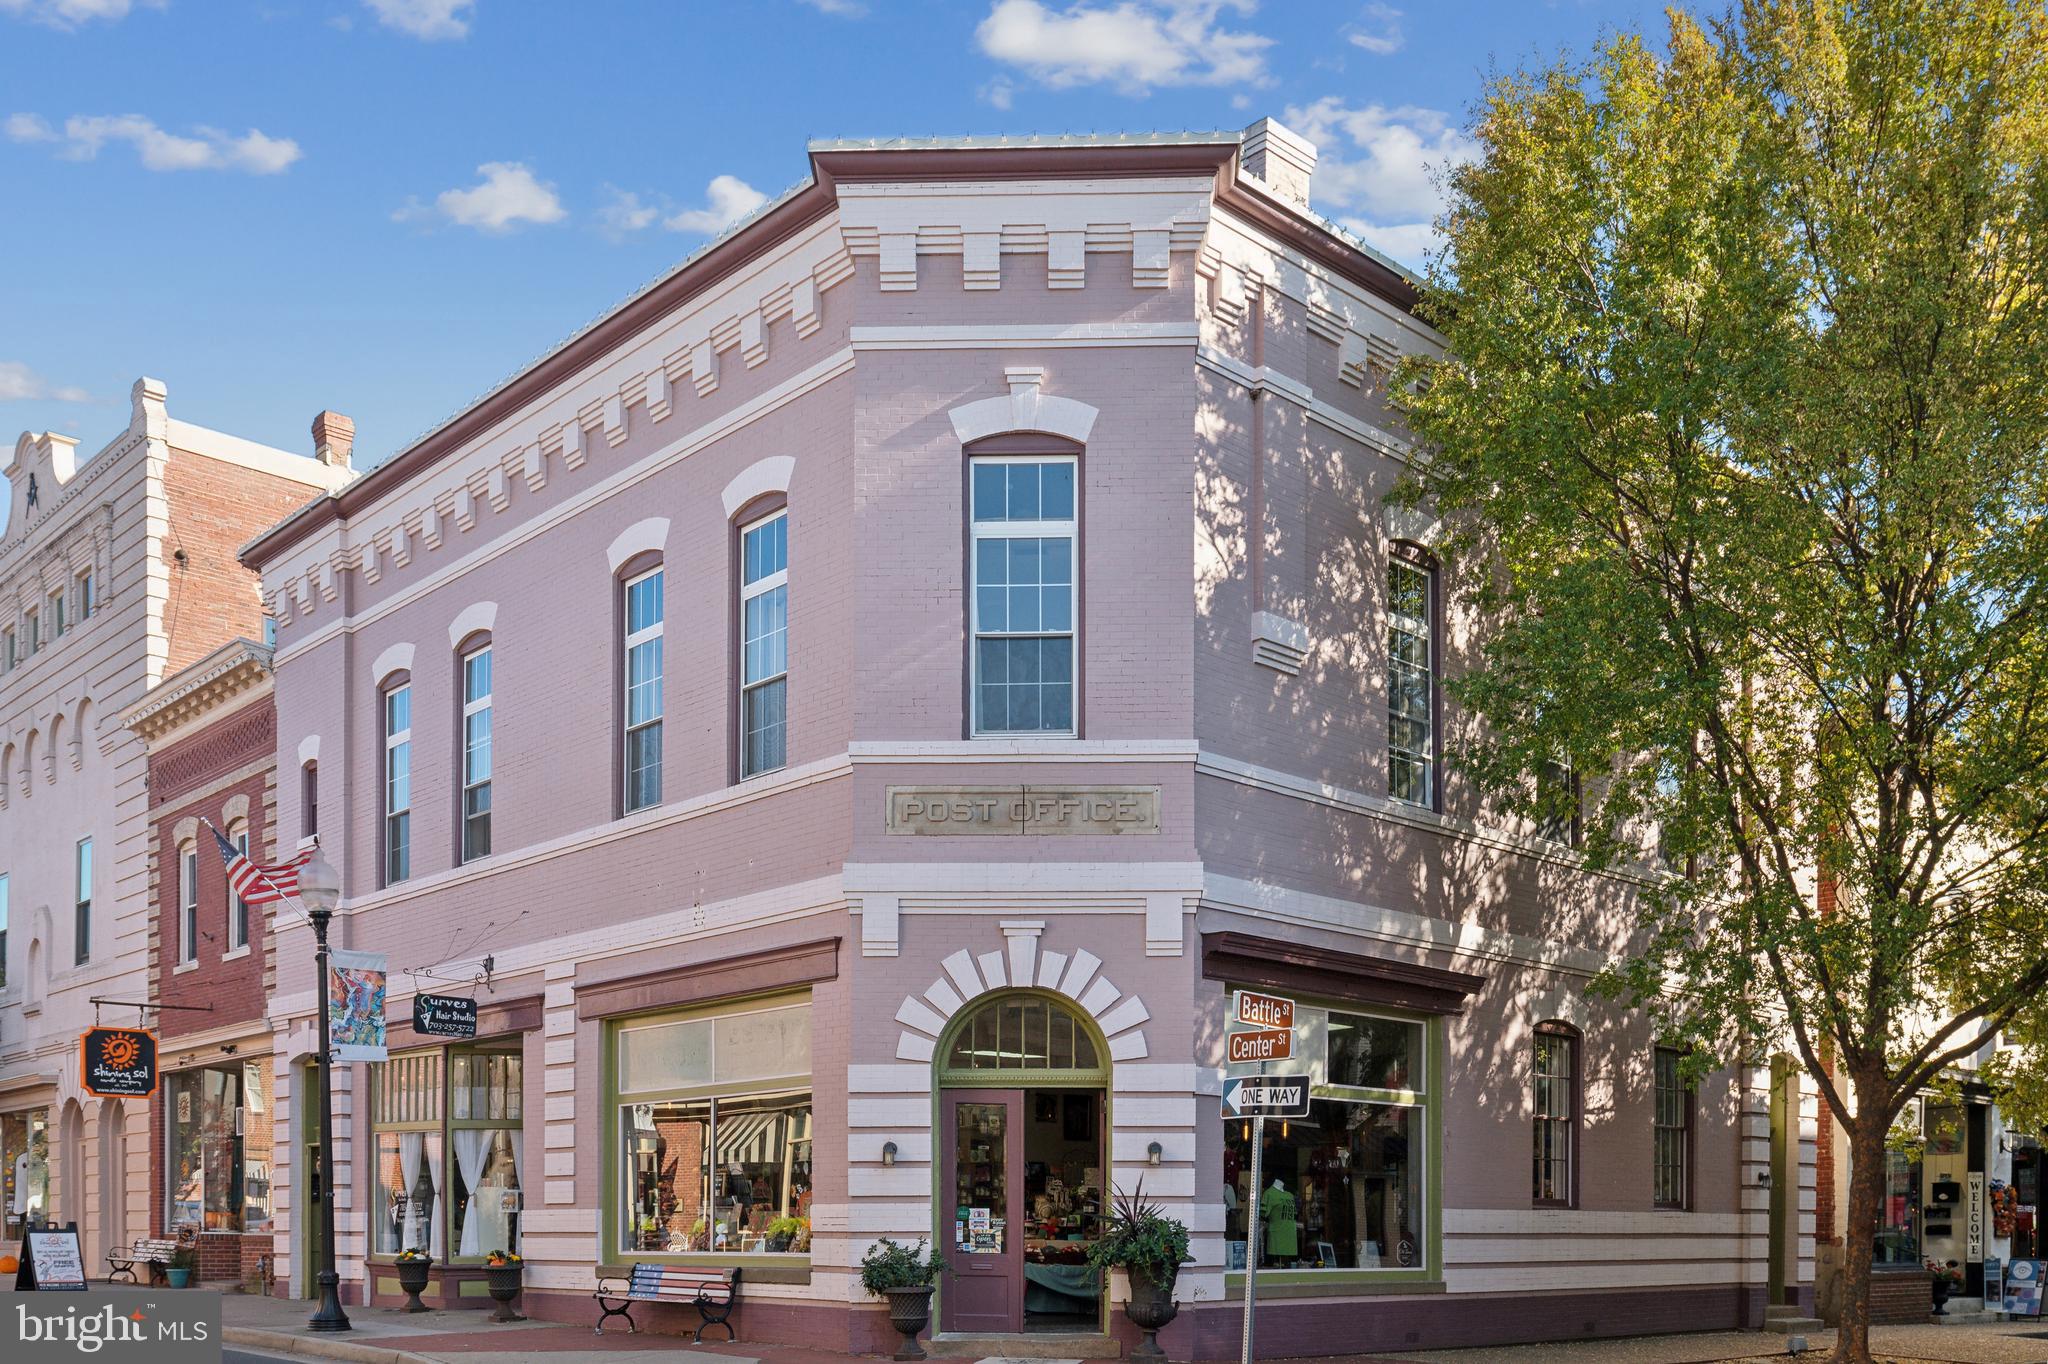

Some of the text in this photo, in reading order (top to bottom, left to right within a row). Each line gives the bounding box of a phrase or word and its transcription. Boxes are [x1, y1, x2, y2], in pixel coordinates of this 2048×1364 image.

[902, 799, 998, 822] POST
[435, 1010, 476, 1022] Hair Studio
[1242, 995, 1290, 1025] Battle St
[429, 1021, 474, 1032] 703-257-5722
[1233, 1032, 1286, 1058] Center St
[93, 1063, 148, 1080] shining sol
[1241, 1088, 1298, 1104] ONE WAY
[1970, 1181, 1981, 1255] WELCOME
